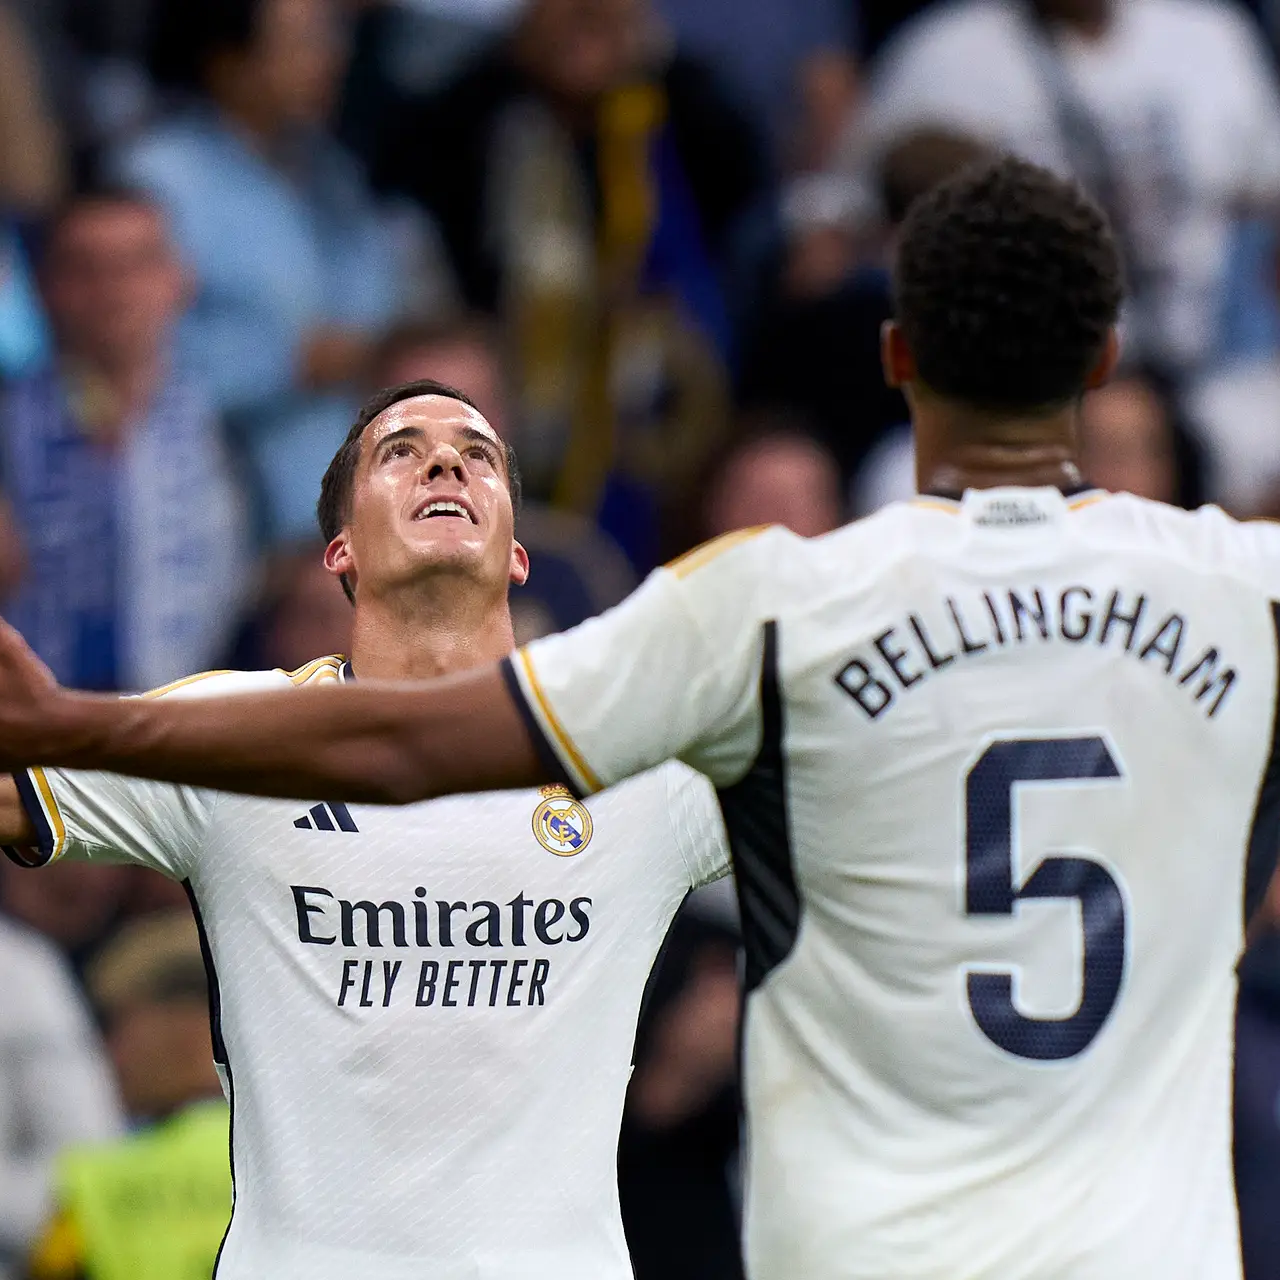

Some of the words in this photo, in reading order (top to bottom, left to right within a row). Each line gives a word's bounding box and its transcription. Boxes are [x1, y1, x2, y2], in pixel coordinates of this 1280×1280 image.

[833, 585, 1238, 720] BELLINGHAM
[289, 885, 593, 948] Emirates
[963, 734, 1127, 1062] 5
[337, 959, 402, 1008] FLY
[415, 958, 551, 1008] BETTER
